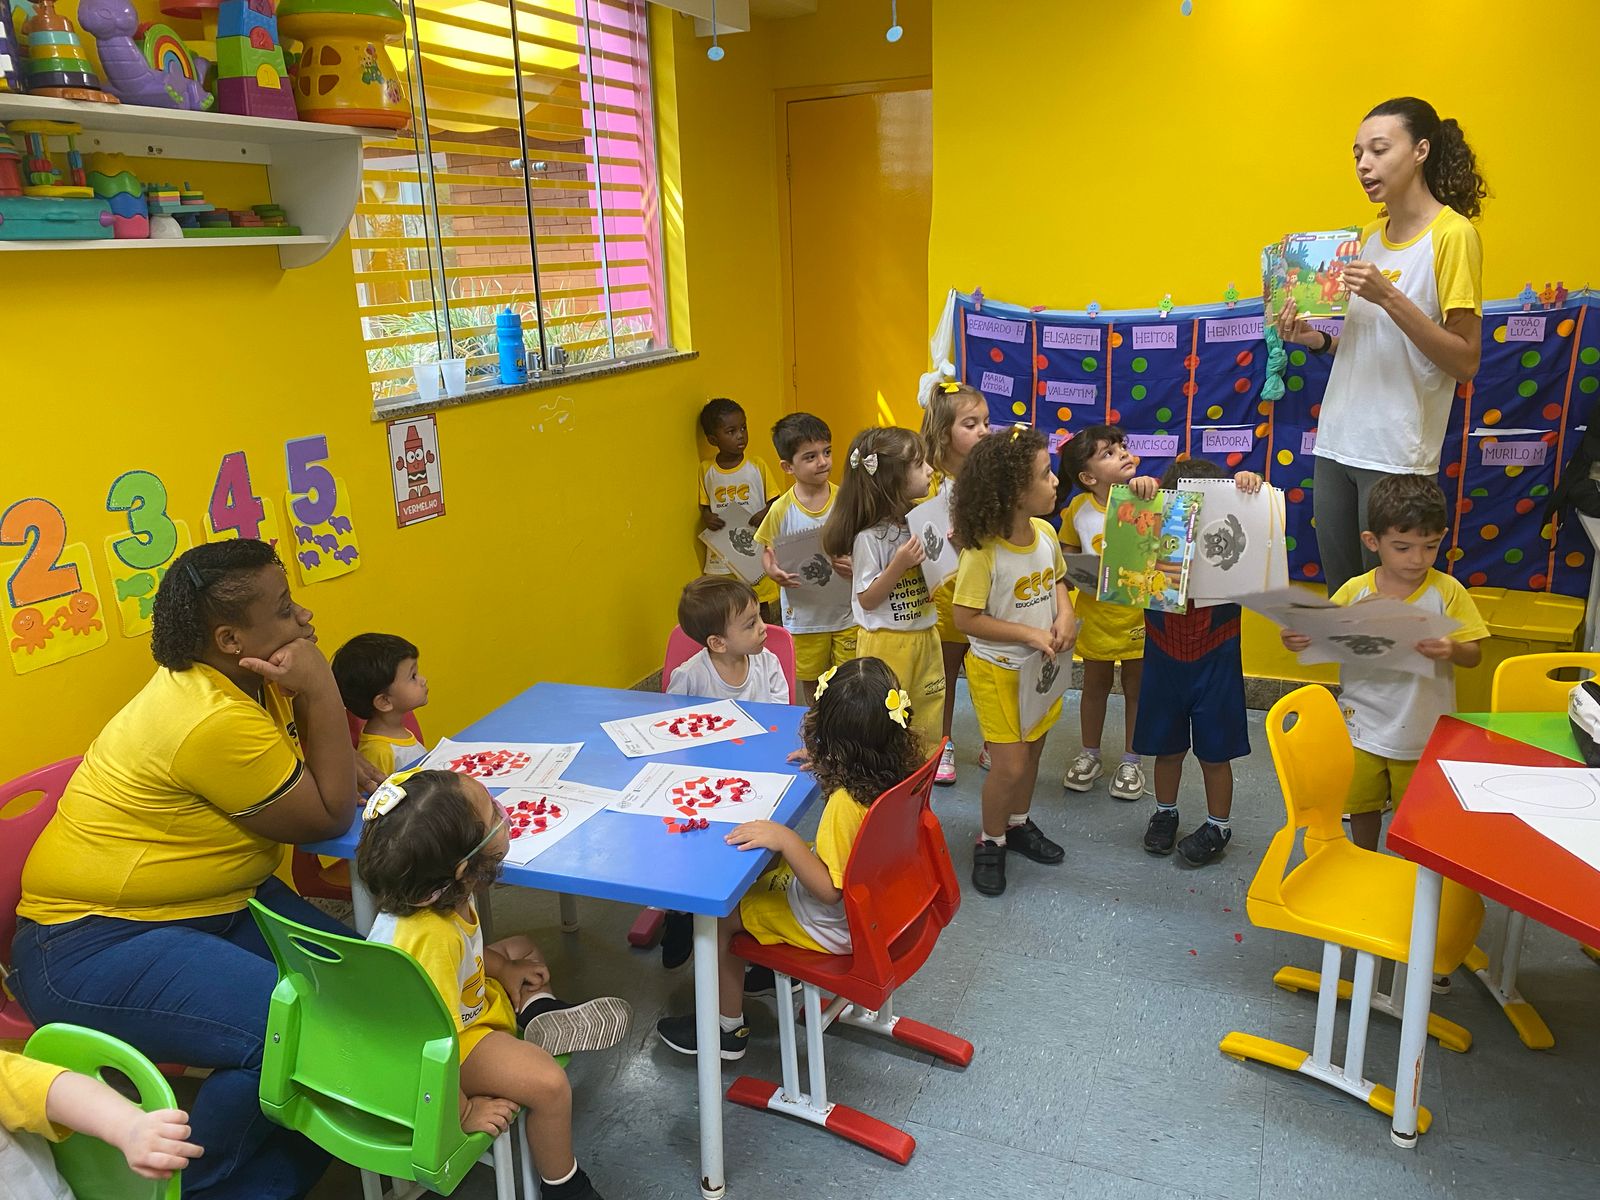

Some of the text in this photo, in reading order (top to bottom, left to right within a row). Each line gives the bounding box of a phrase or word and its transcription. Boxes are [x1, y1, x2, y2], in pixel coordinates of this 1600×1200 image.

[968, 319, 1025, 336] BERNARDO H
[1207, 321, 1264, 338] HENRIQUE
[1513, 317, 1540, 327] JOÃO
[1044, 331, 1099, 346] ELISABETH
[1135, 331, 1175, 344] HEITOR
[1510, 328, 1538, 337] LUCA
[984, 373, 1005, 383] MARIA
[1047, 386, 1094, 399] VALENTIM
[1126, 435, 1175, 451] RANCISCO
[1206, 435, 1250, 447] ISADORA
[1485, 447, 1543, 460] MURILO M
[285, 433, 338, 525] 5
[208, 450, 265, 540] 4
[403, 499, 438, 516] VERMELHO
[106, 469, 178, 570] 3
[0, 497, 82, 609] 2
